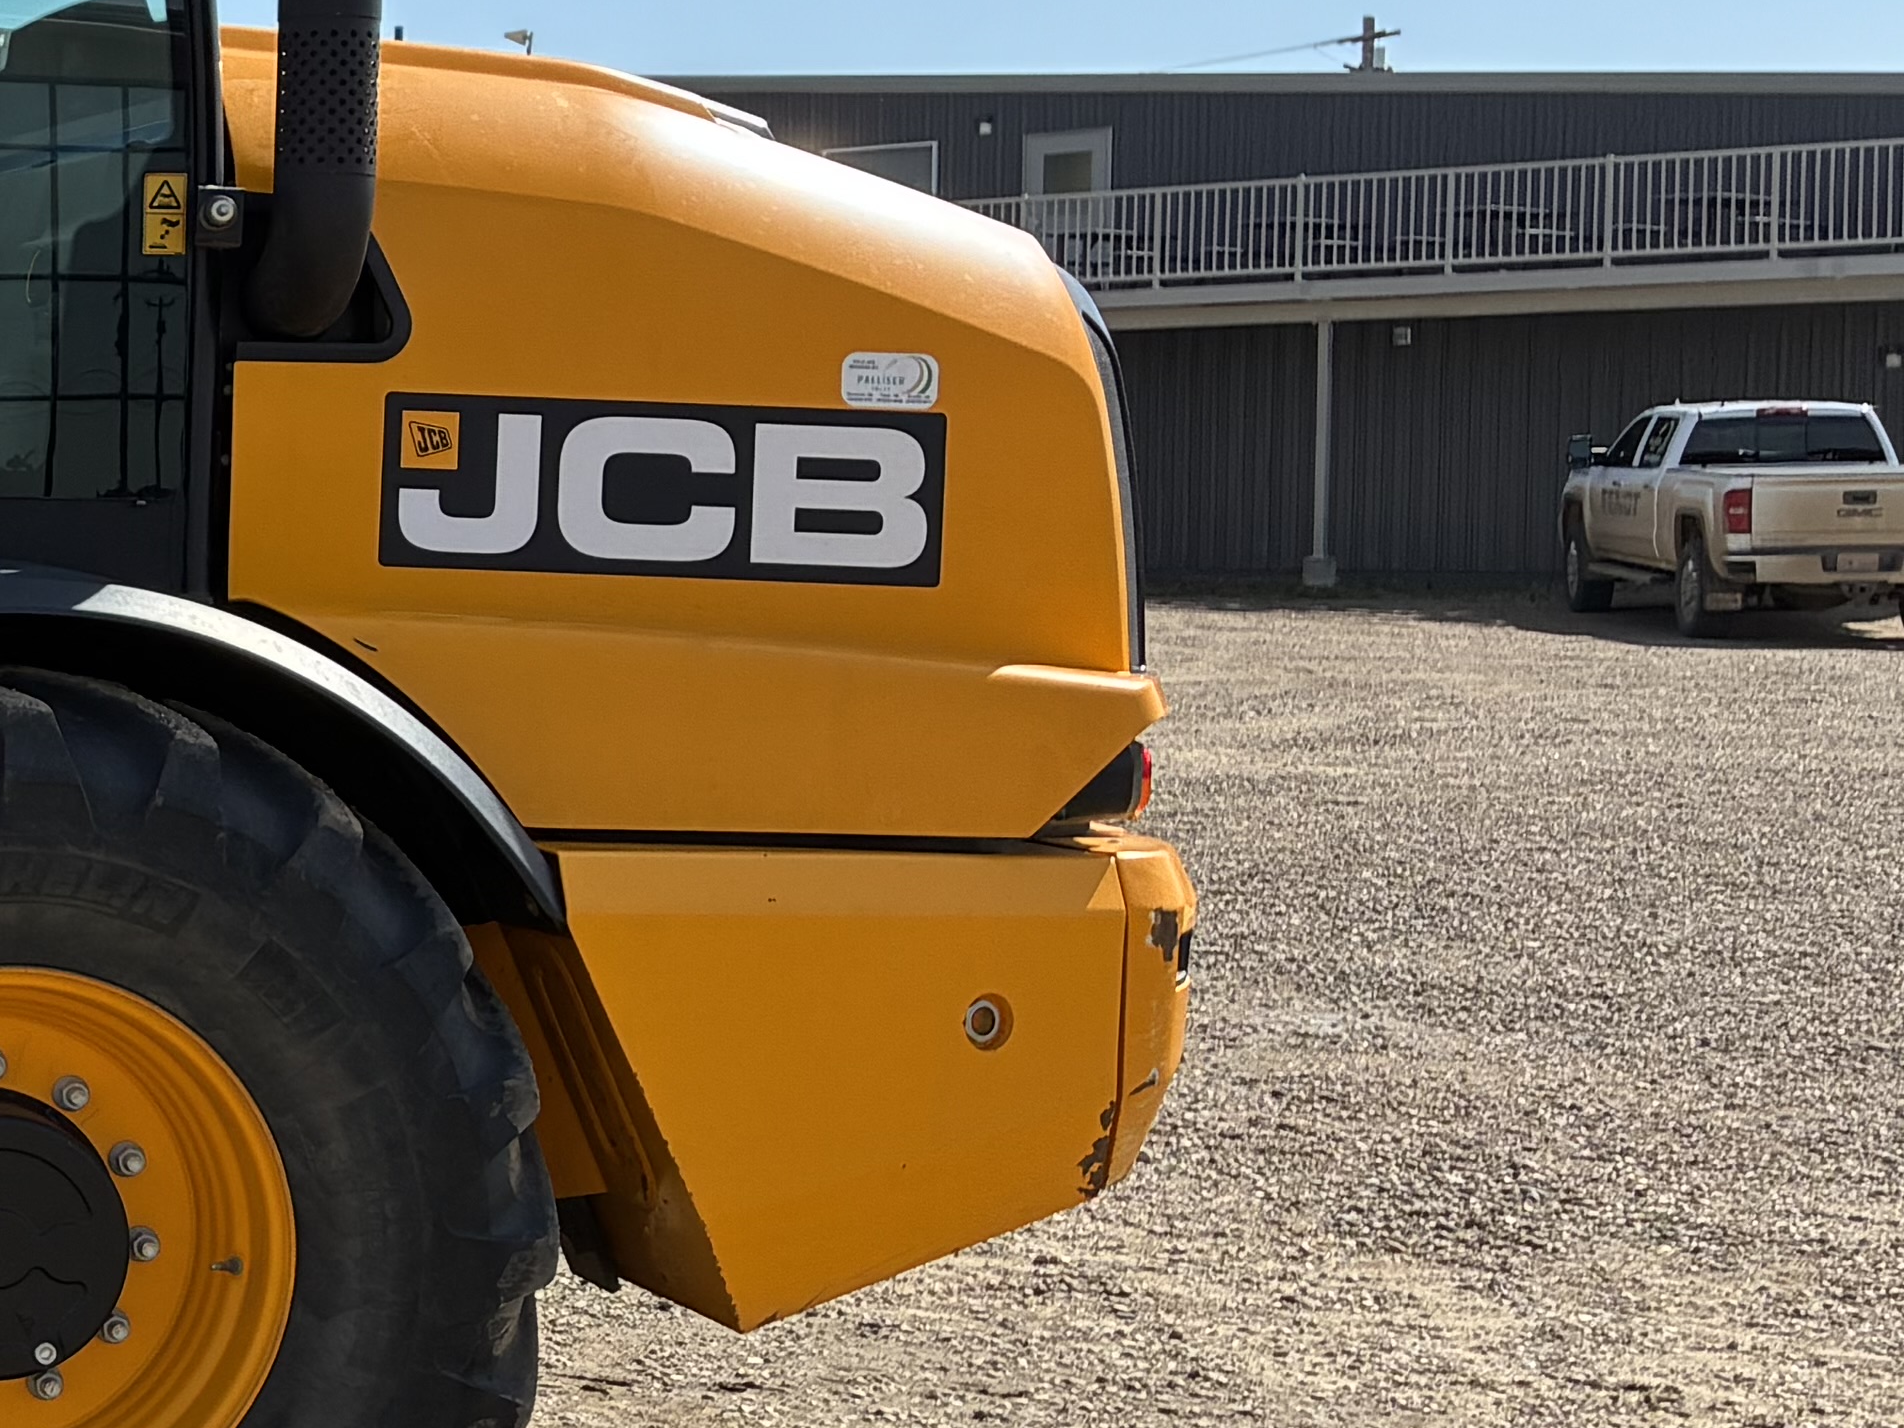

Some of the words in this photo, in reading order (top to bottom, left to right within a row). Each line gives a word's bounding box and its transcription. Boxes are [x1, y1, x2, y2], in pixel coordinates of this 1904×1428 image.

[415, 424, 450, 454] JCB
[398, 413, 929, 570] JCB
[1836, 507, 1884, 518] GMC
